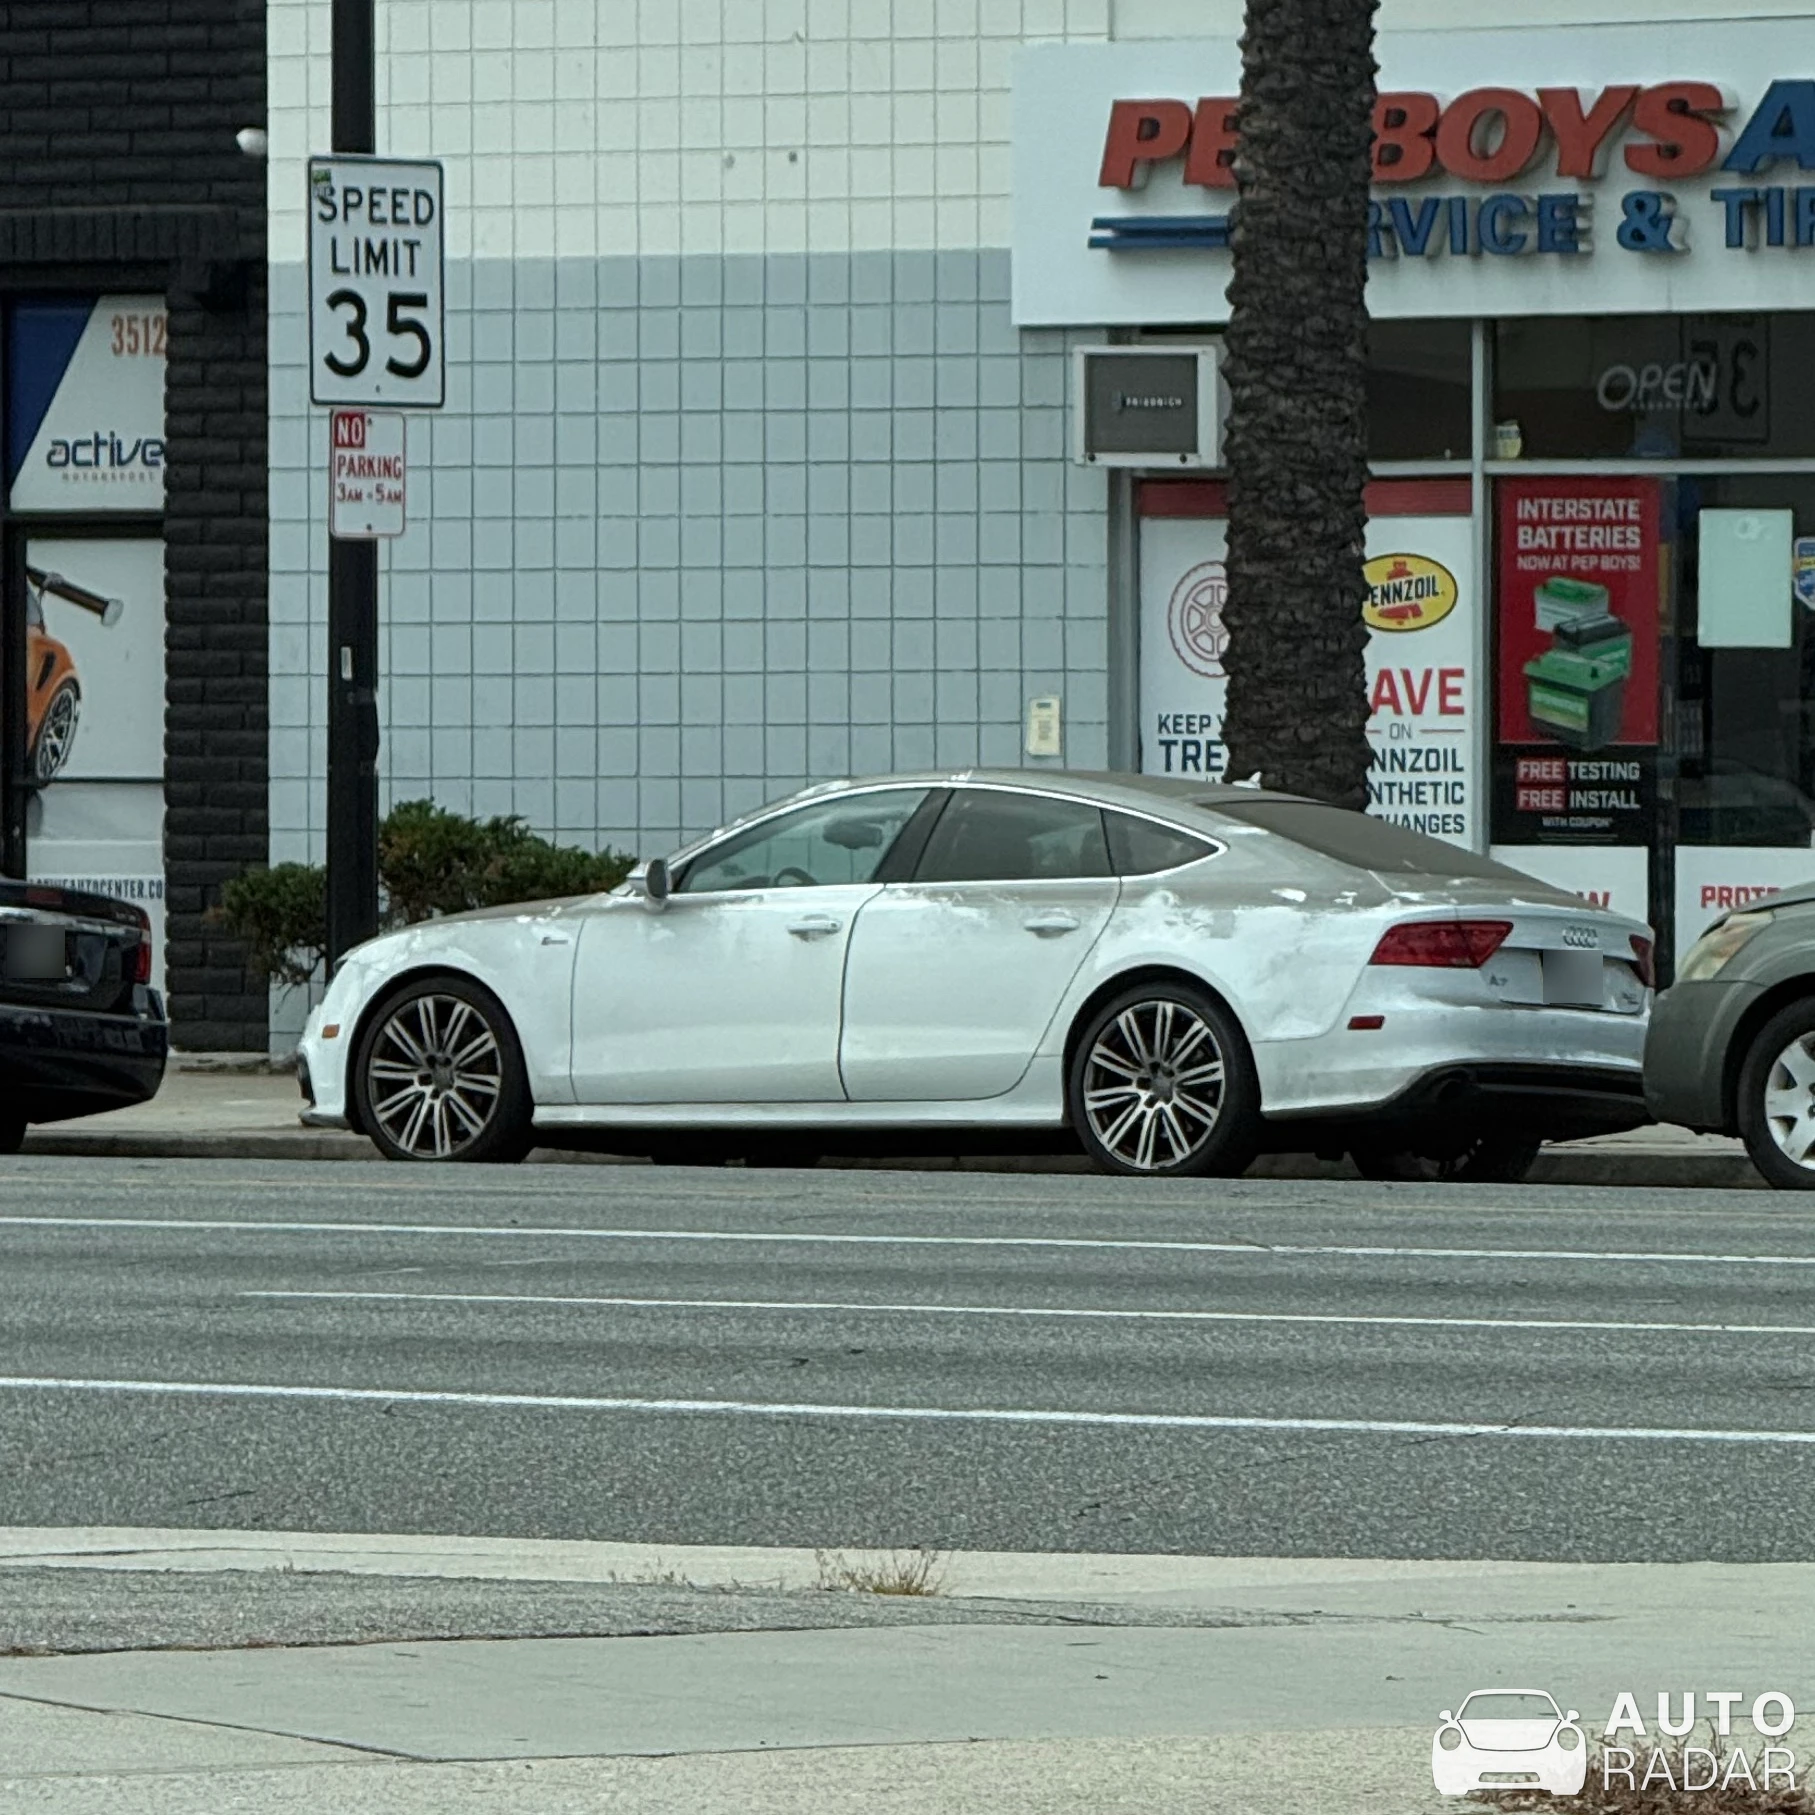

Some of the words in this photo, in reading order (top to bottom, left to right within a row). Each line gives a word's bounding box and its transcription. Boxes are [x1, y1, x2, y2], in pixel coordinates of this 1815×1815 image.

[1371, 81, 1722, 183] BOYS
[317, 186, 434, 225] SPEED
[1617, 191, 1674, 250] &
[330, 236, 421, 276] LIMIT
[111, 314, 166, 357] 3512
[324, 288, 431, 379] 35
[1597, 361, 1716, 411] OPEN
[337, 416, 363, 446] NO
[46, 431, 165, 468] active
[337, 454, 402, 480] PARKING
[1517, 498, 1641, 520] INTERSTATE
[1517, 525, 1641, 549] BATTERIES
[1367, 575, 1440, 608] ENNZOIL
[1158, 714, 1211, 734] KEEP
[1389, 723, 1412, 739] ON
[1519, 761, 1563, 780] FREE
[1568, 761, 1640, 780] TESTING
[1519, 790, 1563, 809] FREE
[1569, 790, 1640, 809] INSTALL
